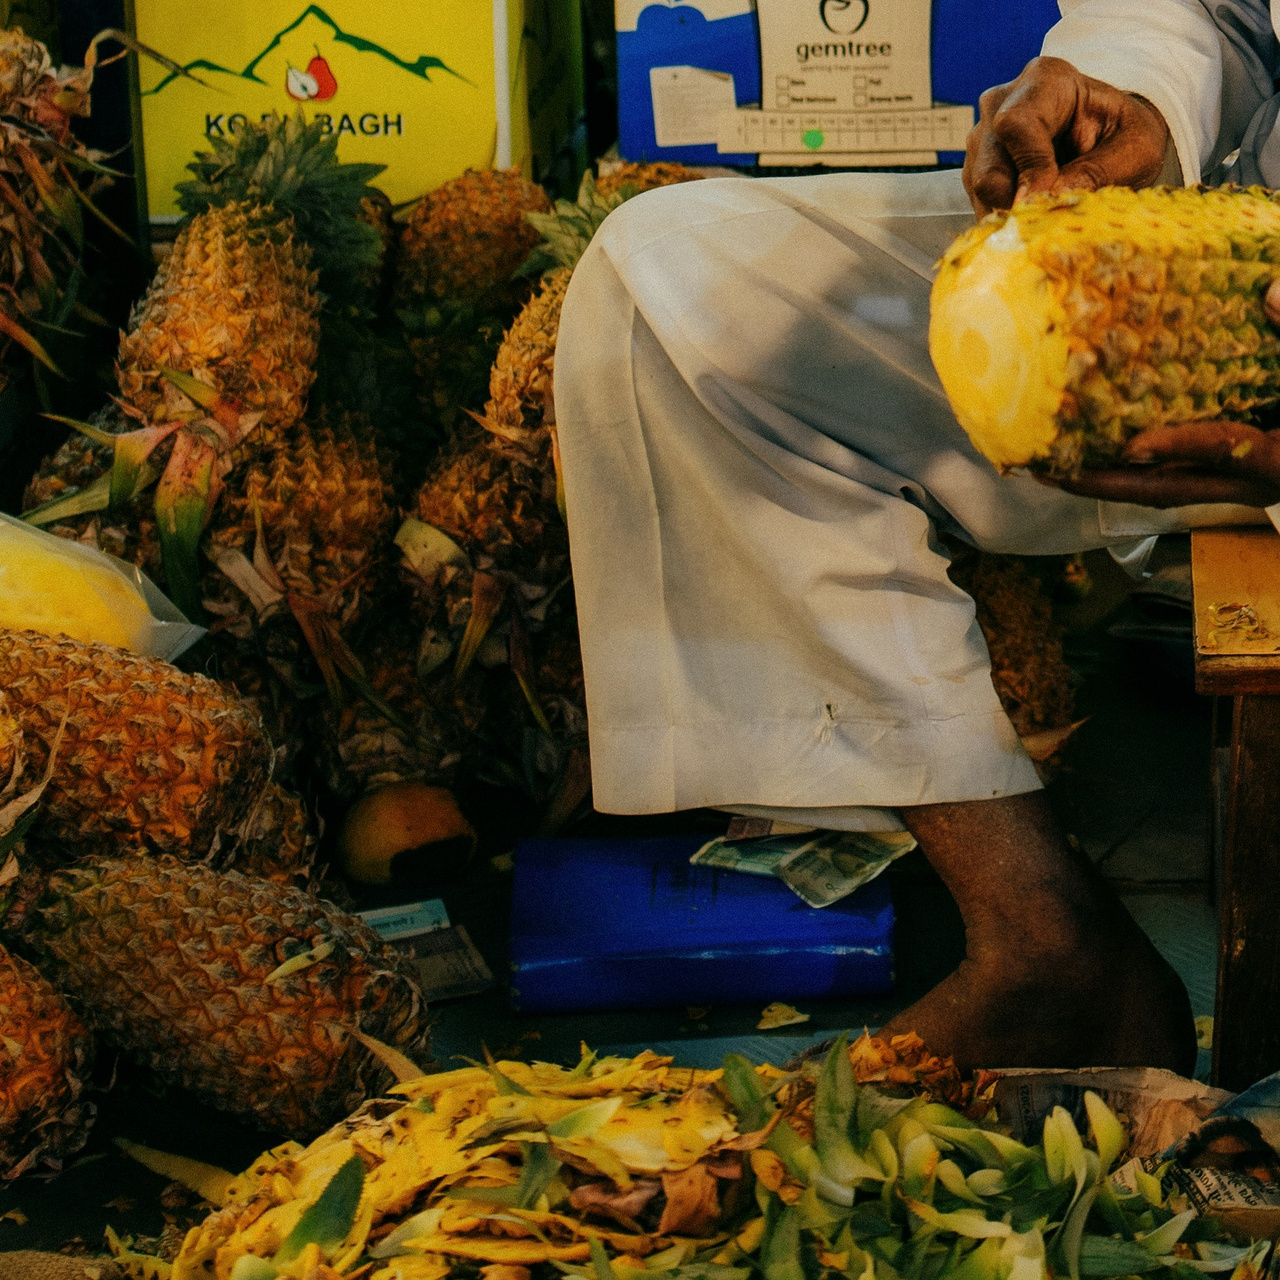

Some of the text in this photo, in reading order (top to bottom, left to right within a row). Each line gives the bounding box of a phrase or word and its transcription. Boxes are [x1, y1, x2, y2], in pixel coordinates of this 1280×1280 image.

[796, 39, 892, 65] gemtree
[206, 113, 245, 136] KO
[315, 113, 402, 136] BAGH
